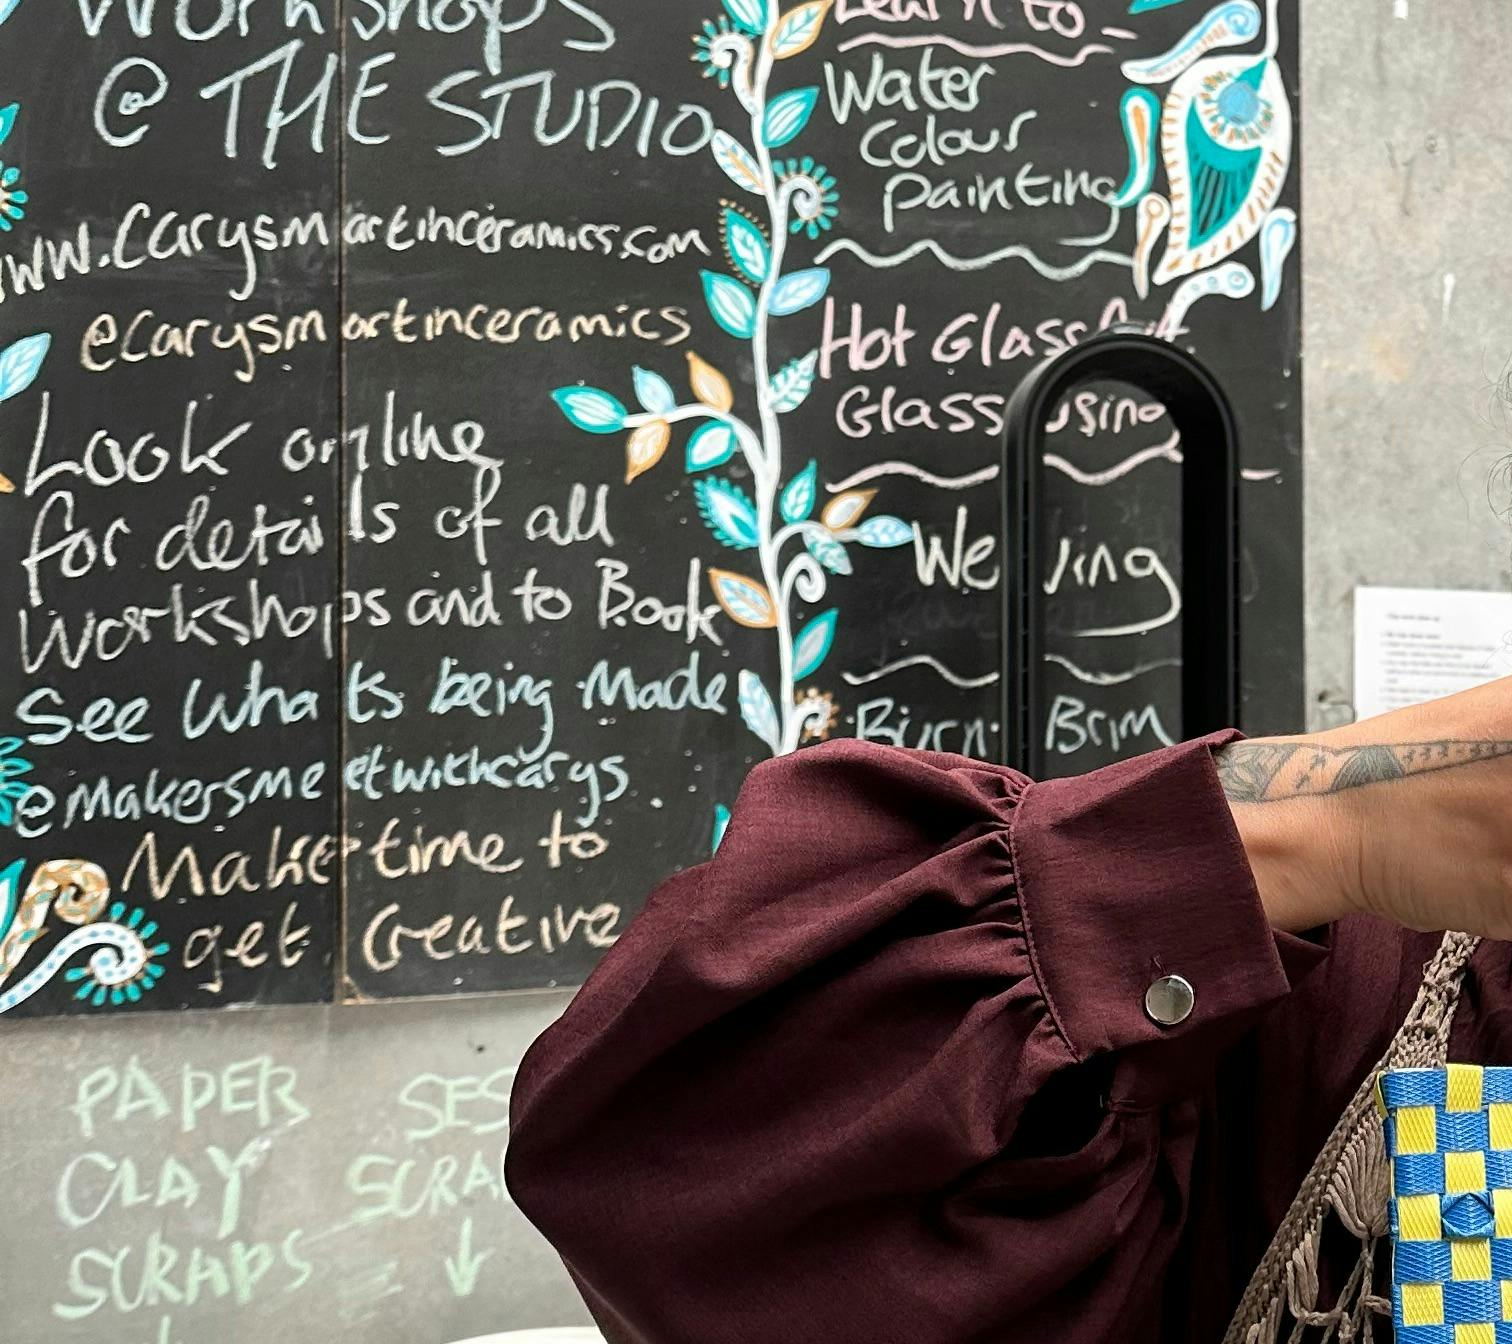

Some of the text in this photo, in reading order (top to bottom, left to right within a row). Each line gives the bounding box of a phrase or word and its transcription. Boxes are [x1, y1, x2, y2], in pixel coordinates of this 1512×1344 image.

[199, 40, 396, 168] THE
[426, 68, 714, 157] STUDIO
[824, 47, 996, 125] Water
[818, 296, 918, 380] Hot
[23, 390, 252, 498] Look
[23, 463, 614, 607] for details of all
[406, 568, 503, 627] and
[511, 568, 573, 622] to
[595, 558, 726, 646] Book
[428, 657, 554, 761] being
[368, 816, 524, 878] time
[538, 809, 609, 869] to
[183, 902, 312, 992] get
[72, 1054, 311, 1138] PAPER
[55, 1136, 508, 1240] CLAY SCRA
[52, 1228, 313, 1319] SCRAPS
